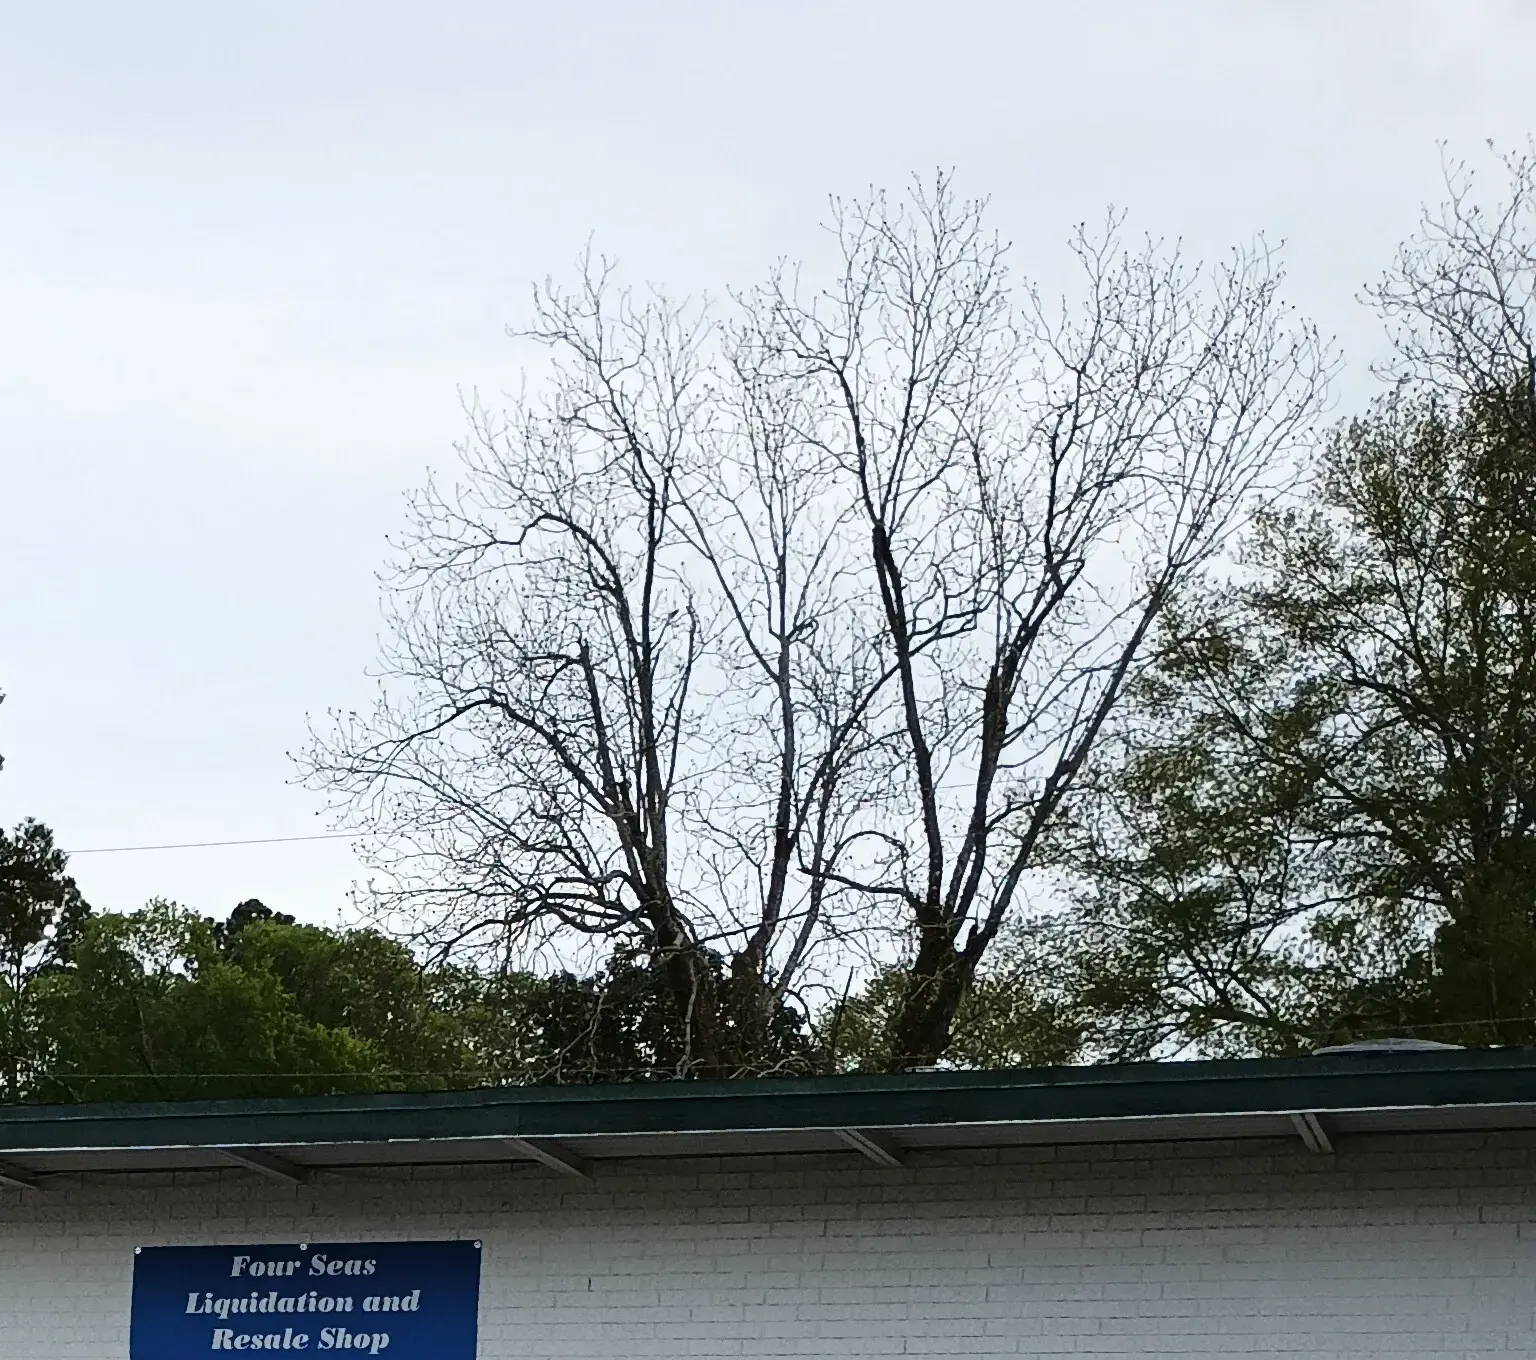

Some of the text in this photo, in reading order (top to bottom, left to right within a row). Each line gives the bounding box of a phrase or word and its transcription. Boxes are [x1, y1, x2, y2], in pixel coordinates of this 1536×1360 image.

[230, 1253, 377, 1277] Four Seas
[185, 1290, 421, 1319] Liquidation and
[211, 1327, 390, 1355] Resale Shop
